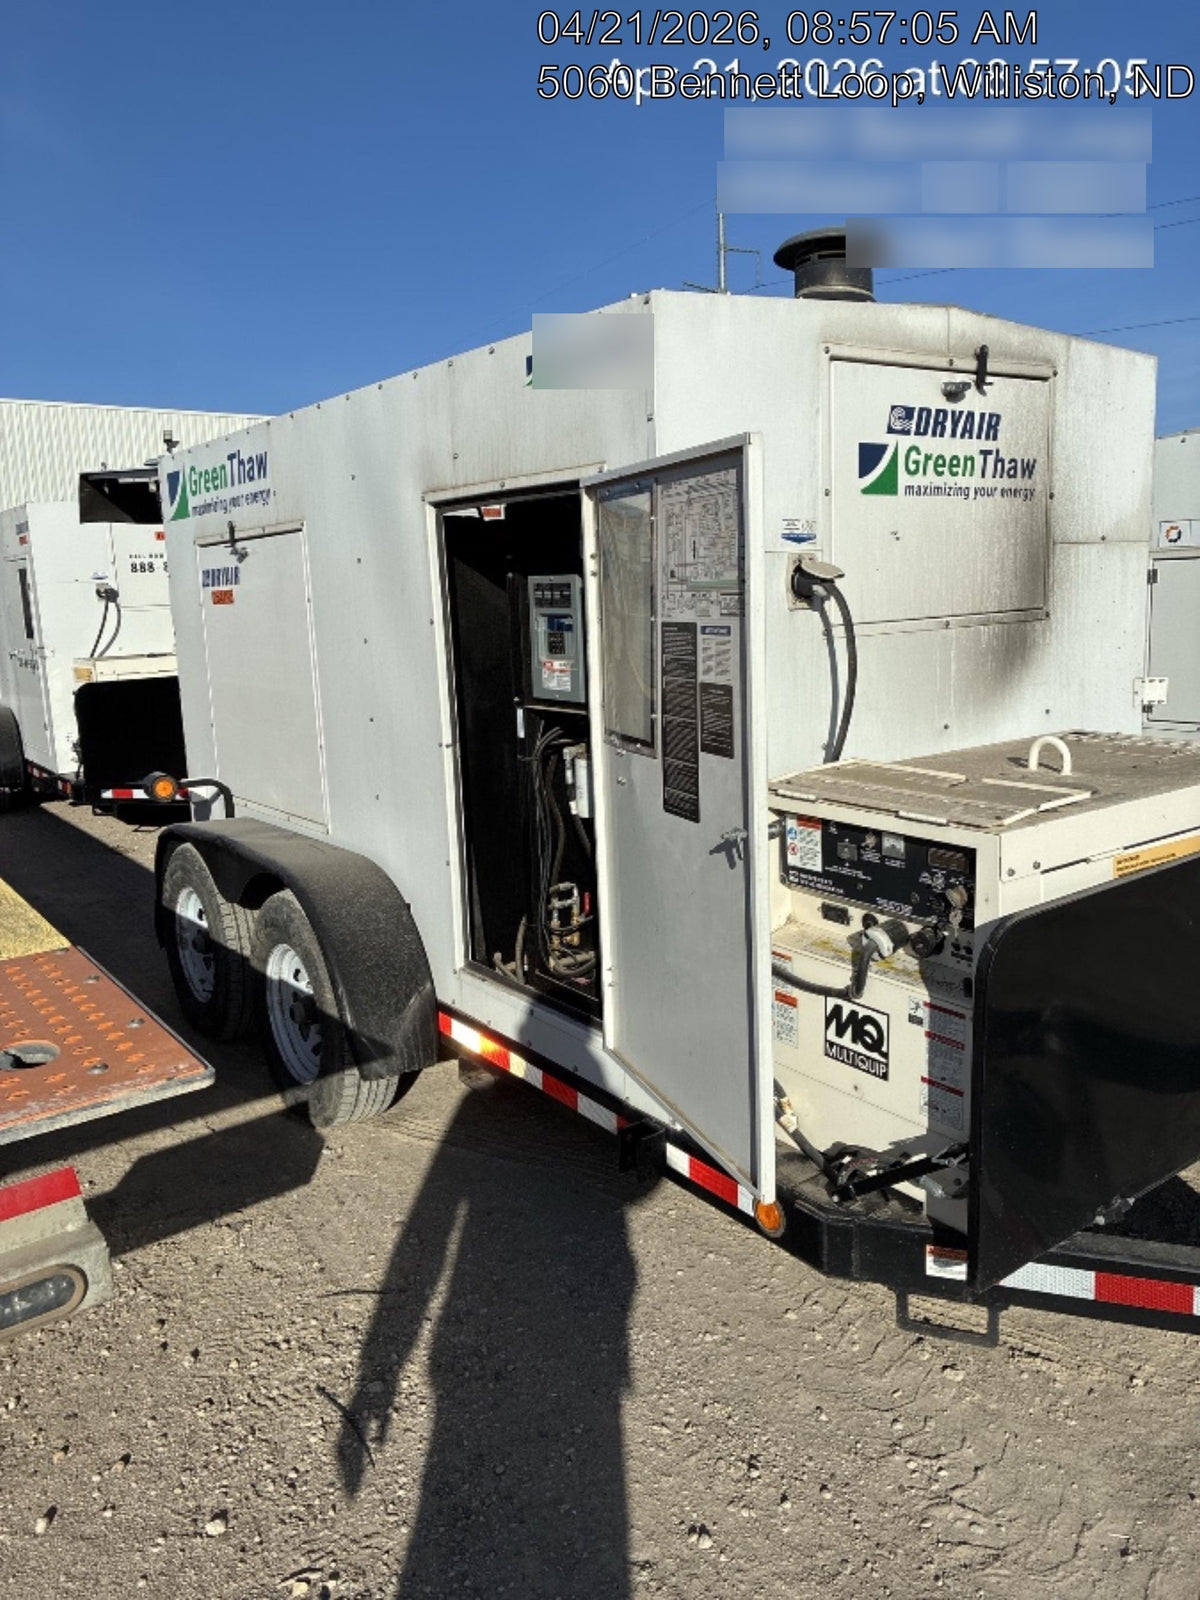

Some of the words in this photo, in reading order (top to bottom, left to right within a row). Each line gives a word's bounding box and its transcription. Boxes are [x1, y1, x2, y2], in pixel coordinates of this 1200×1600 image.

[914, 406, 1003, 441] DRYAIR
[904, 481, 970, 501] maximizing
[973, 486, 998, 501] your
[1000, 486, 1036, 502] energy
[826, 1003, 889, 1059] MQ
[826, 1041, 887, 1077] MULTIQUIP
